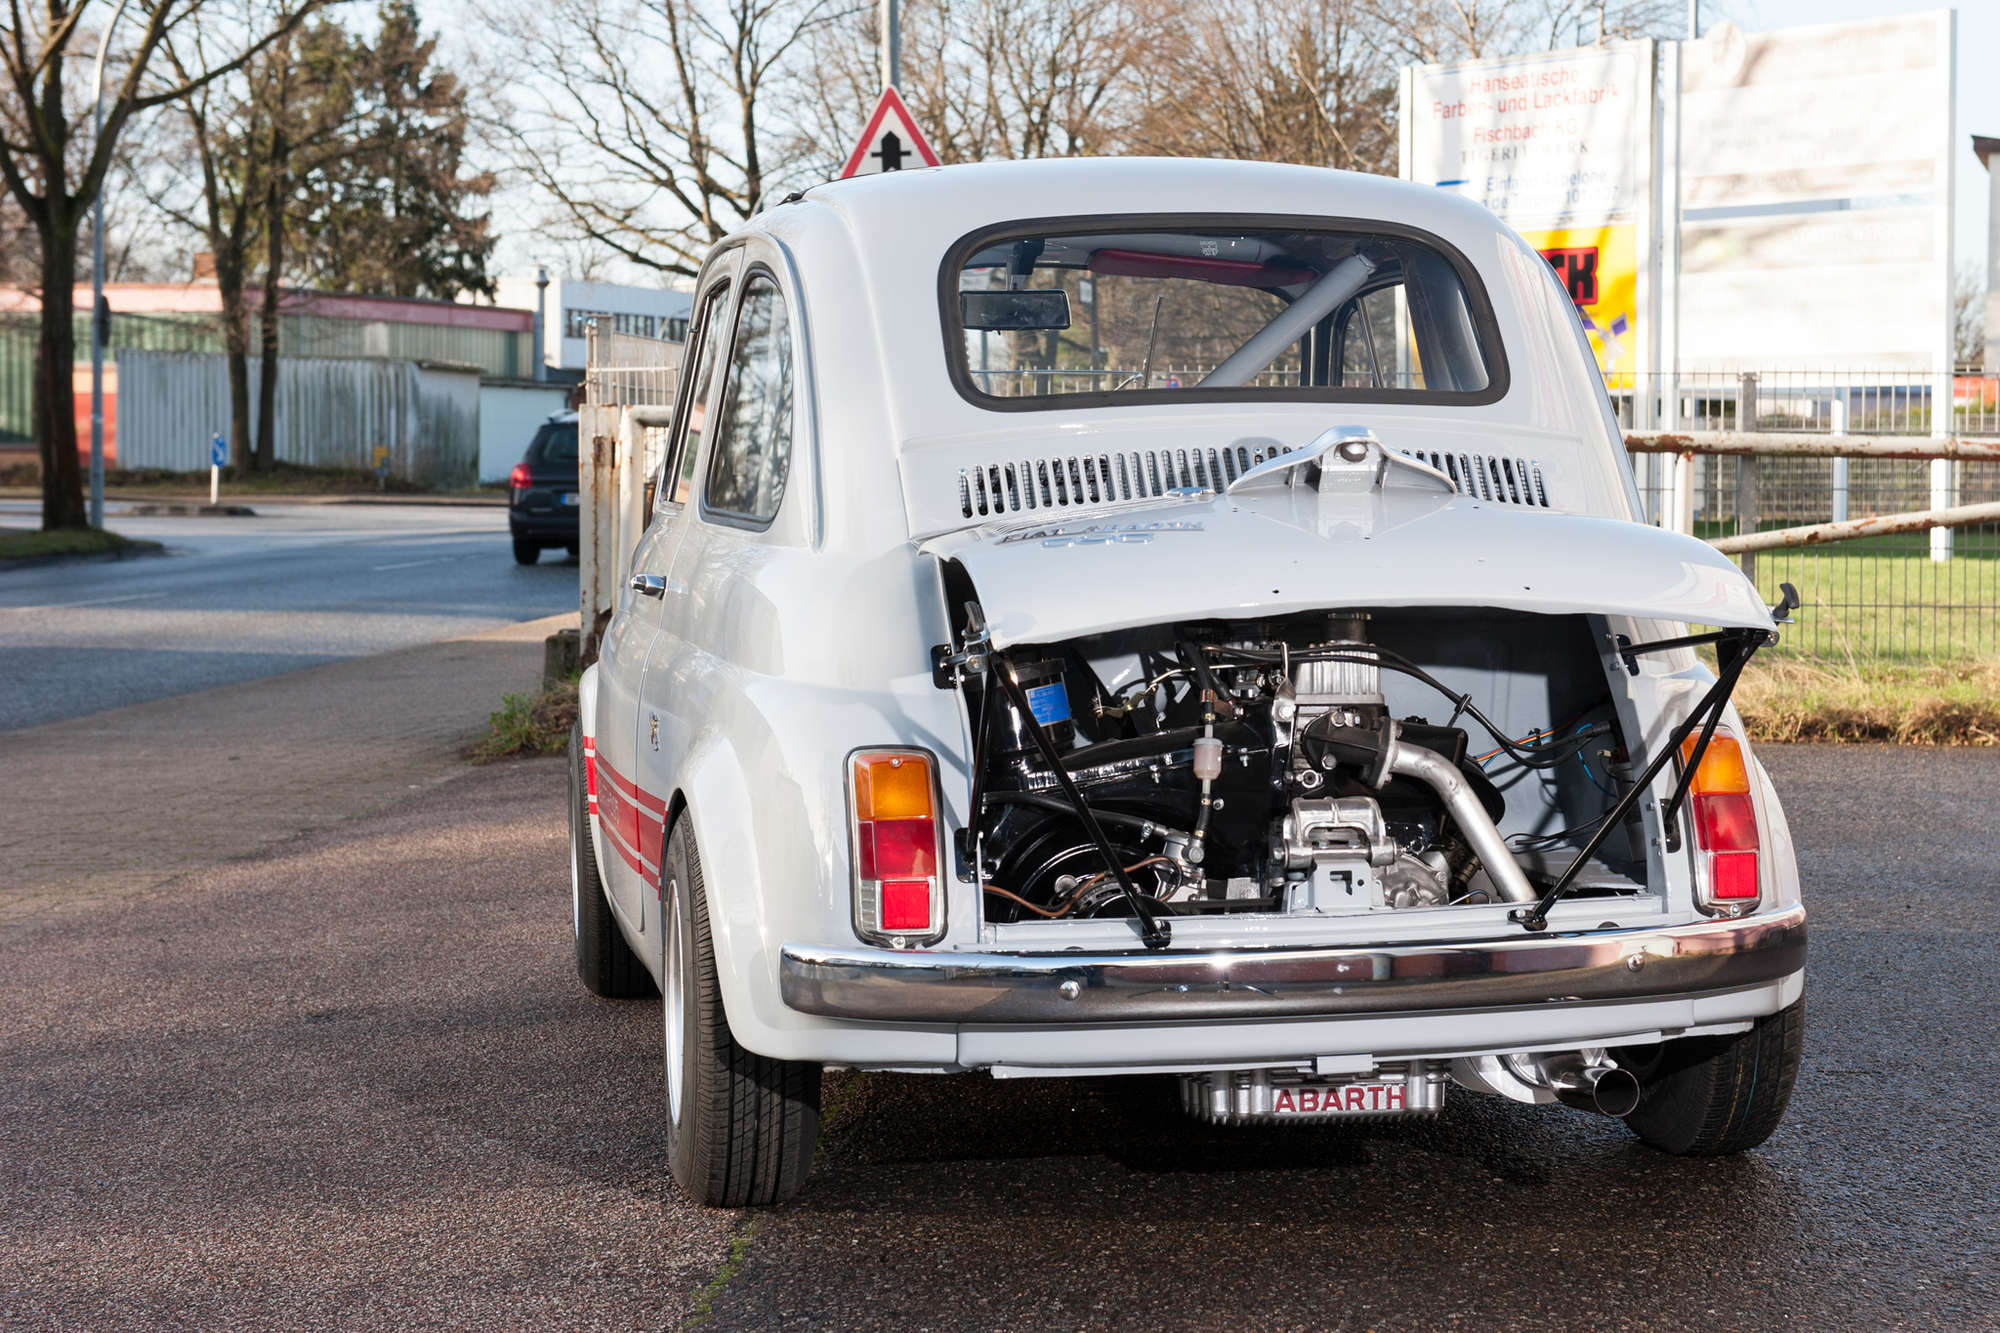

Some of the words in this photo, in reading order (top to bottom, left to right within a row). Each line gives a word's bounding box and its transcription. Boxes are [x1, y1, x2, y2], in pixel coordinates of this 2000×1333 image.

[1470, 65, 1579, 94] Hanseatische
[1433, 101, 1493, 120] Farben-
[1497, 95, 1528, 114] und
[1533, 81, 1619, 110] Lackfabrik
[1474, 121, 1544, 144] Fischbach
[1555, 117, 1577, 135] KG
[1274, 1085, 1406, 1113] ABARTH
